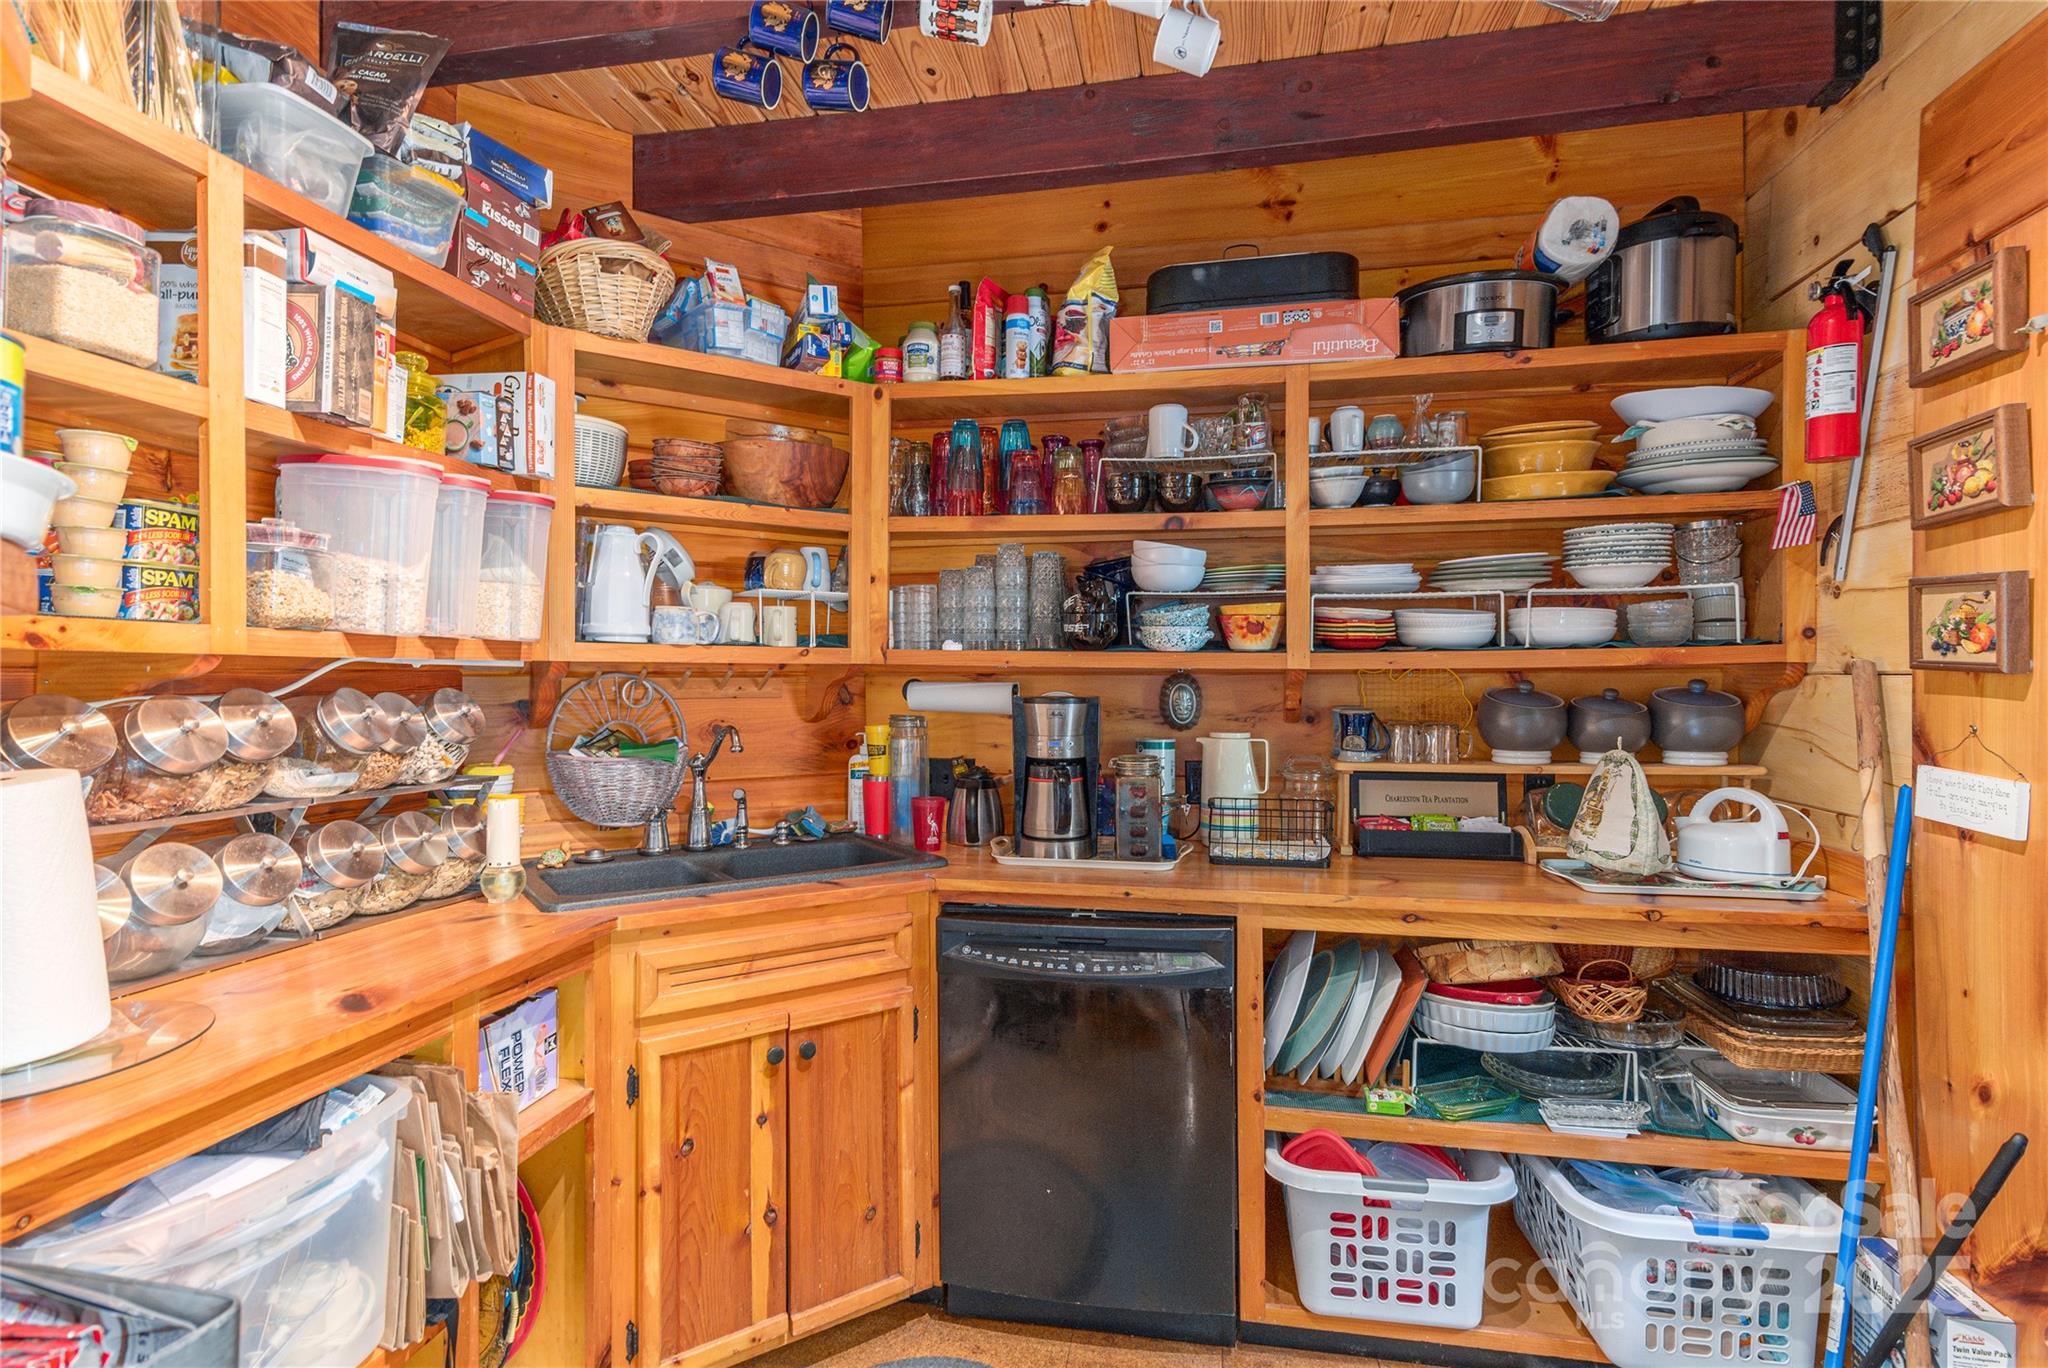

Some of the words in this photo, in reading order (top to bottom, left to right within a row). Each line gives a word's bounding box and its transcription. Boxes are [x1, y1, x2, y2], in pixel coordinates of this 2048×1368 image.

[358, 69, 387, 78] CACAO
[304, 327, 315, 355] WHOLE
[1312, 338, 1379, 355] Beautiful
[145, 509, 197, 531] SPAM
[148, 531, 163, 540] LESS
[141, 569, 194, 588] SPAM
[146, 591, 160, 600] LESS
[499, 1046, 512, 1093] FLEX
[1972, 1348, 1992, 1356] Value
